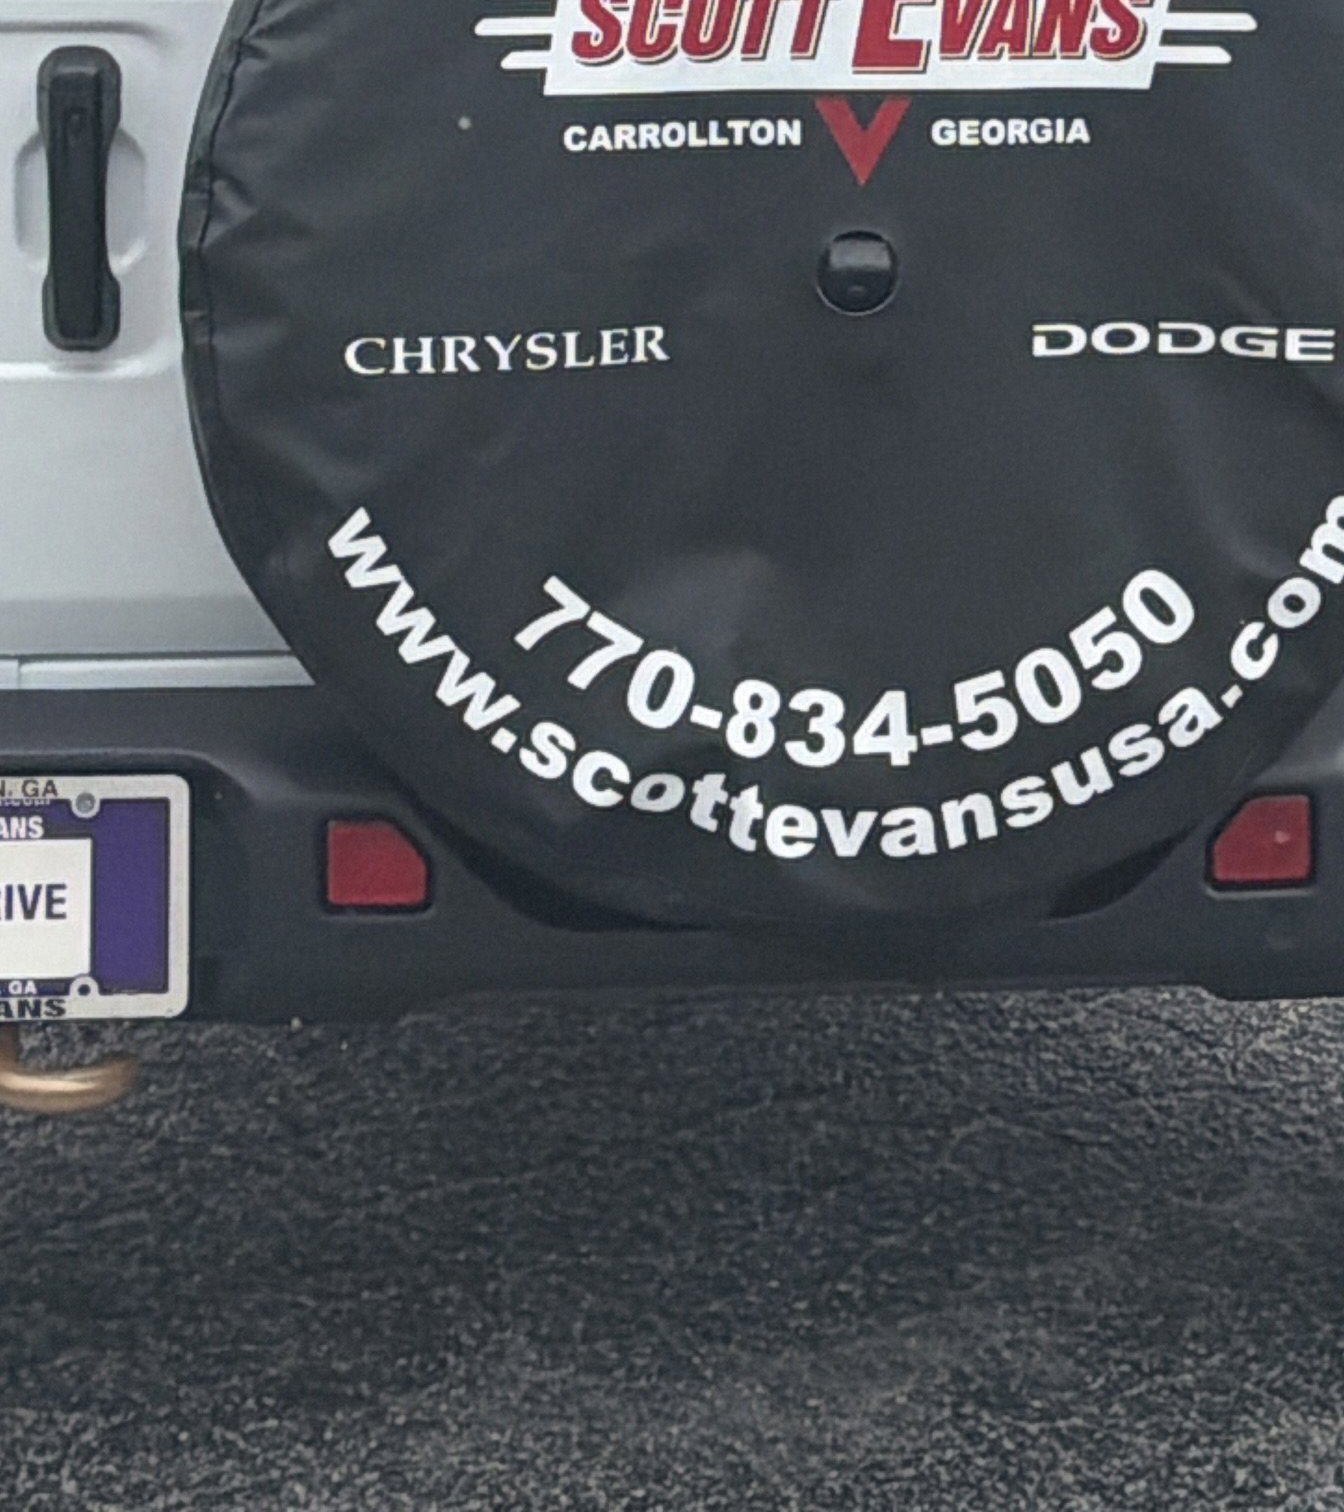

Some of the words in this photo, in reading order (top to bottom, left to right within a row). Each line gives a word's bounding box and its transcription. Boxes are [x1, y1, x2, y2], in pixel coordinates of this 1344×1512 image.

[563, 118, 802, 152] CARROLLTON
[931, 117, 1091, 147] GEORGIA
[344, 325, 670, 376] CHRYSLER
[1032, 321, 1336, 362] DODGE
[513, 568, 1196, 768] 770-834-5050
[22, 779, 58, 797] GA
[9, 980, 37, 995] GA
